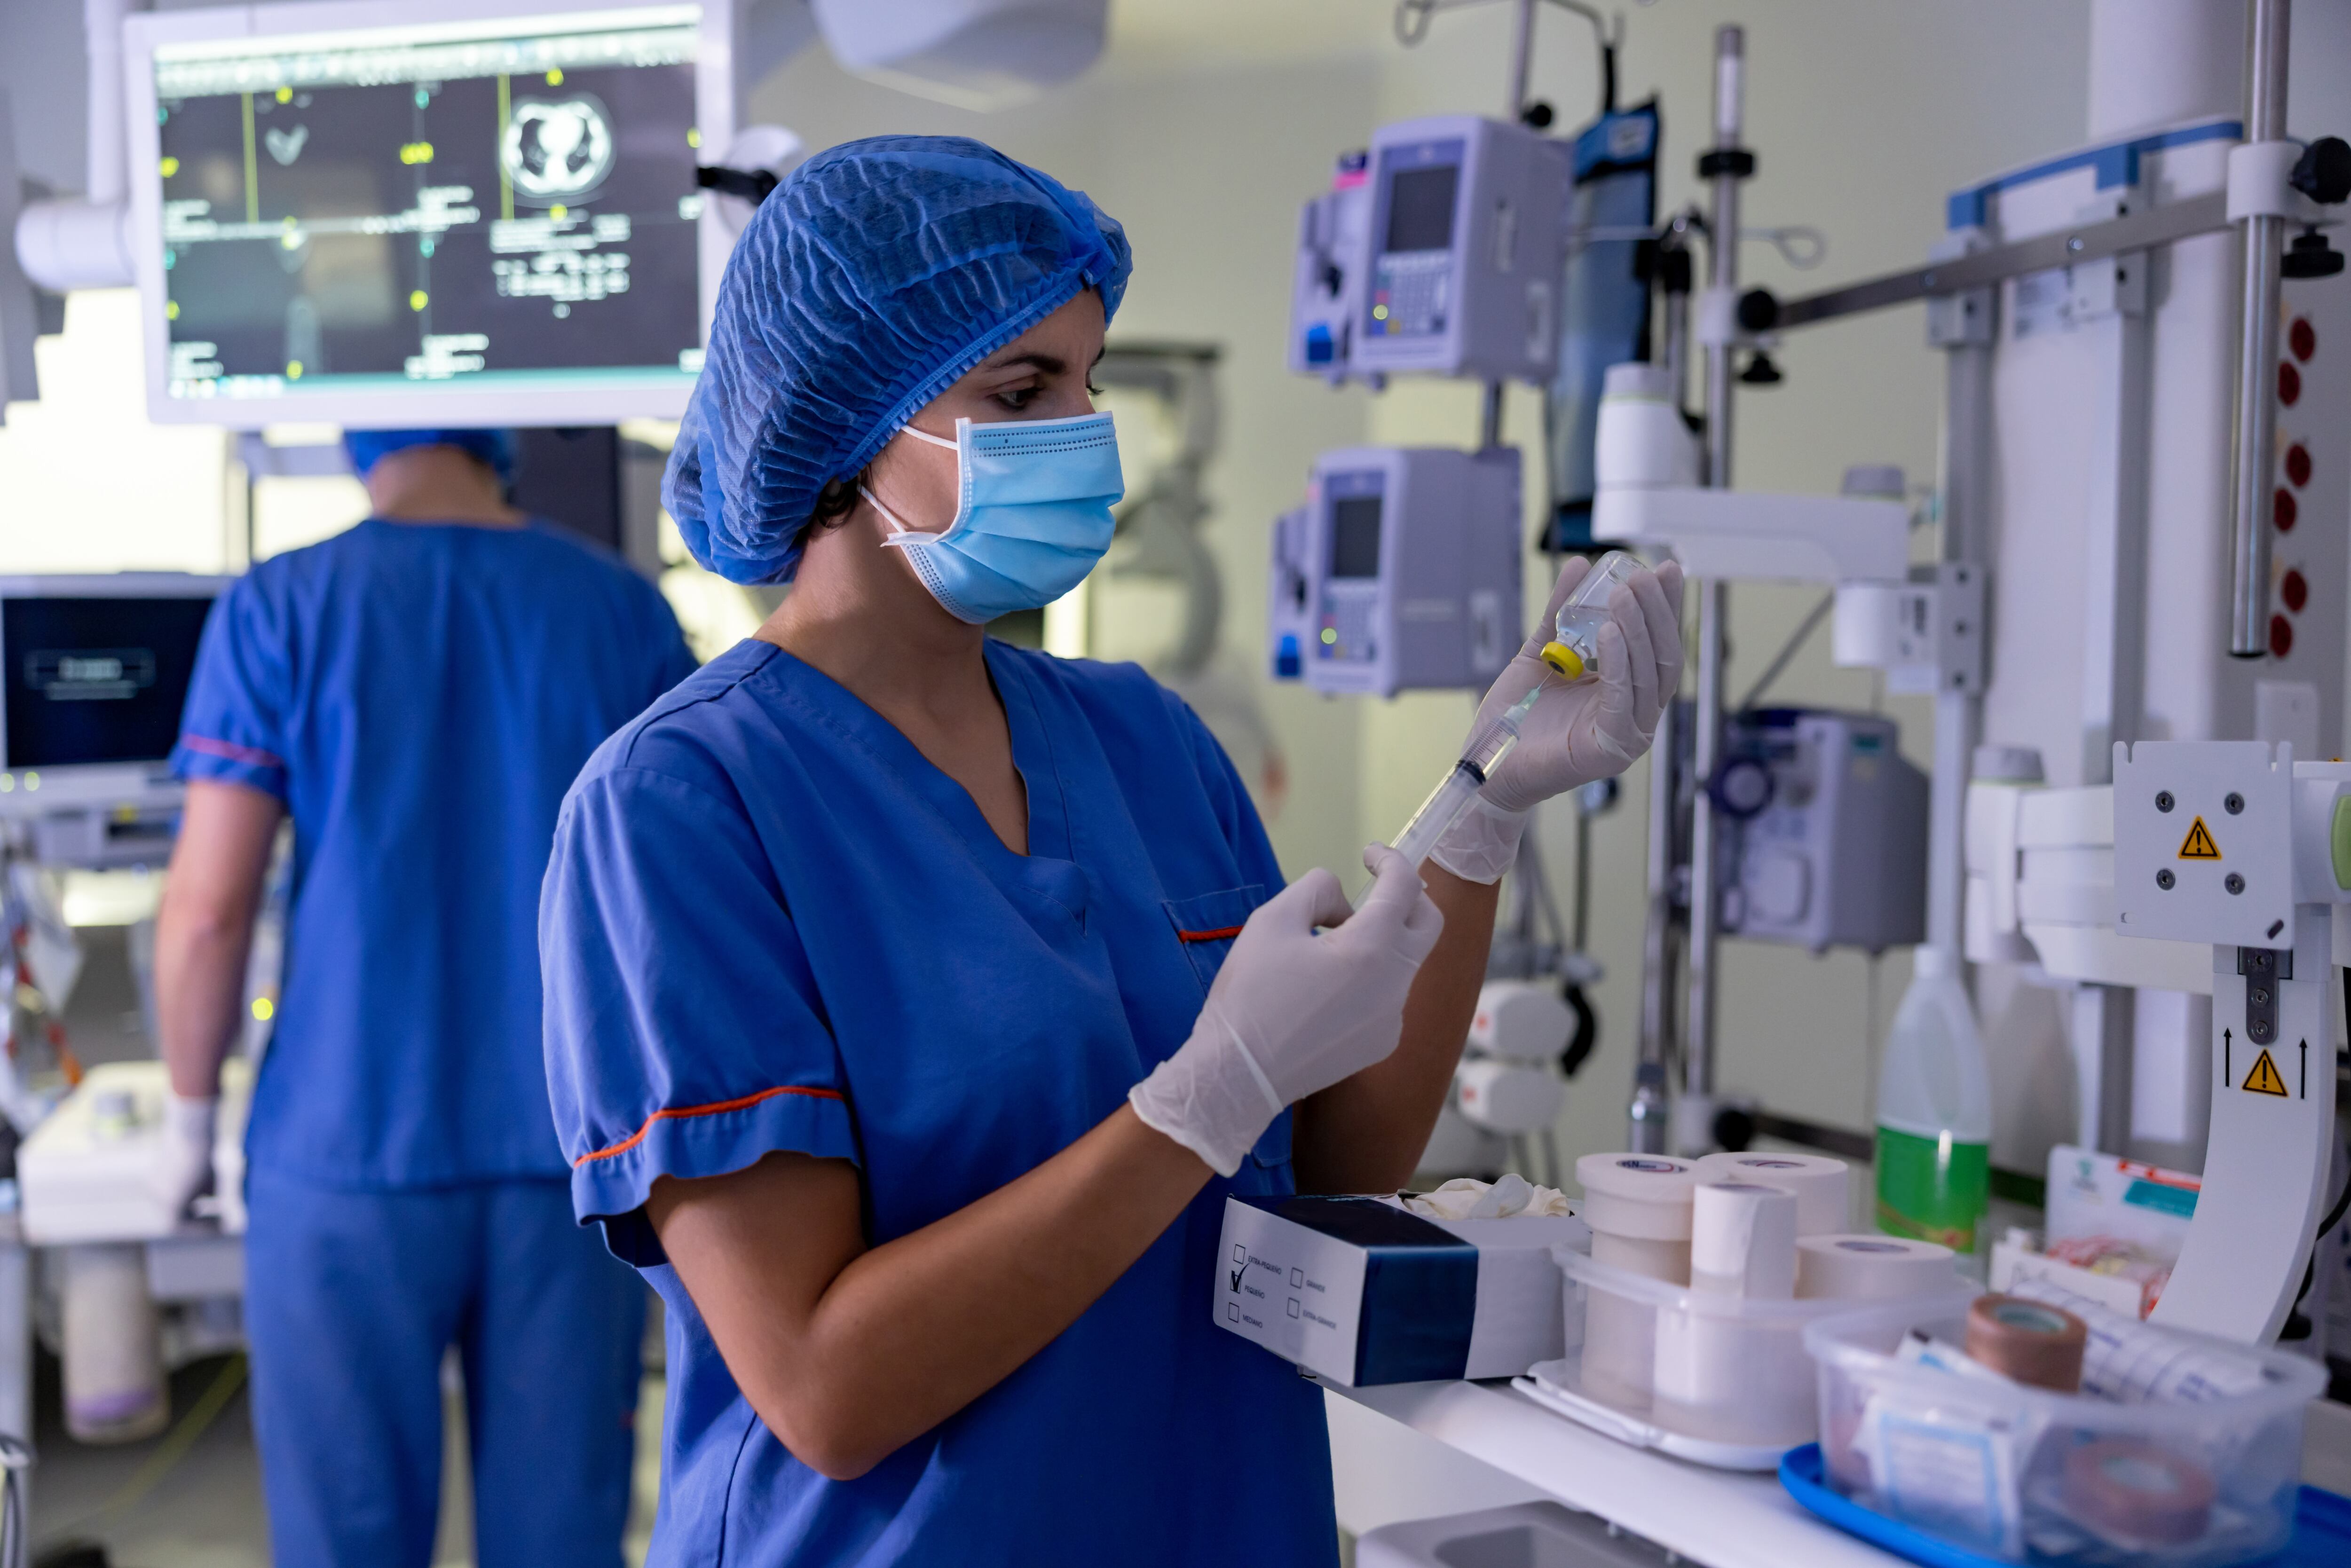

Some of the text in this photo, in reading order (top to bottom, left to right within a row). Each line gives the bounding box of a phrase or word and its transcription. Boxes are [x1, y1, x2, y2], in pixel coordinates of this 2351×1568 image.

[1248, 1256, 1281, 1275] EXTRA-PEQUEÑO
[1245, 1285, 1265, 1299] PEQUEÑO
[1243, 1315, 1262, 1328] MEDIANO
